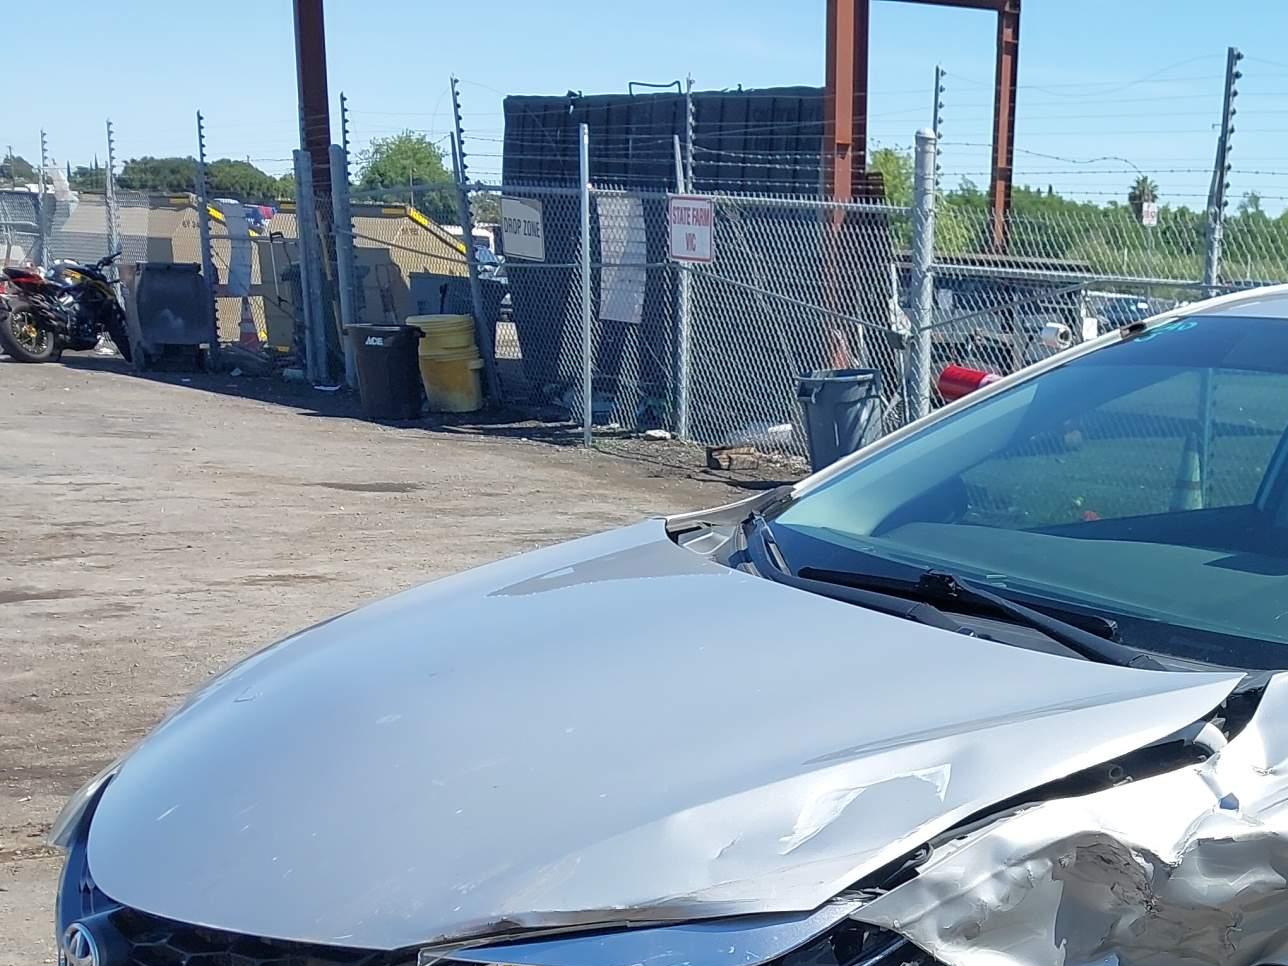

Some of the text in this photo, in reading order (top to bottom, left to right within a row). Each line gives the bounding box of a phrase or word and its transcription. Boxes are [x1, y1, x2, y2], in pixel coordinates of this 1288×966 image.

[673, 206, 710, 227] STATE FARM
[504, 217, 540, 238] DROP ZONE
[365, 336, 385, 346] ACE
